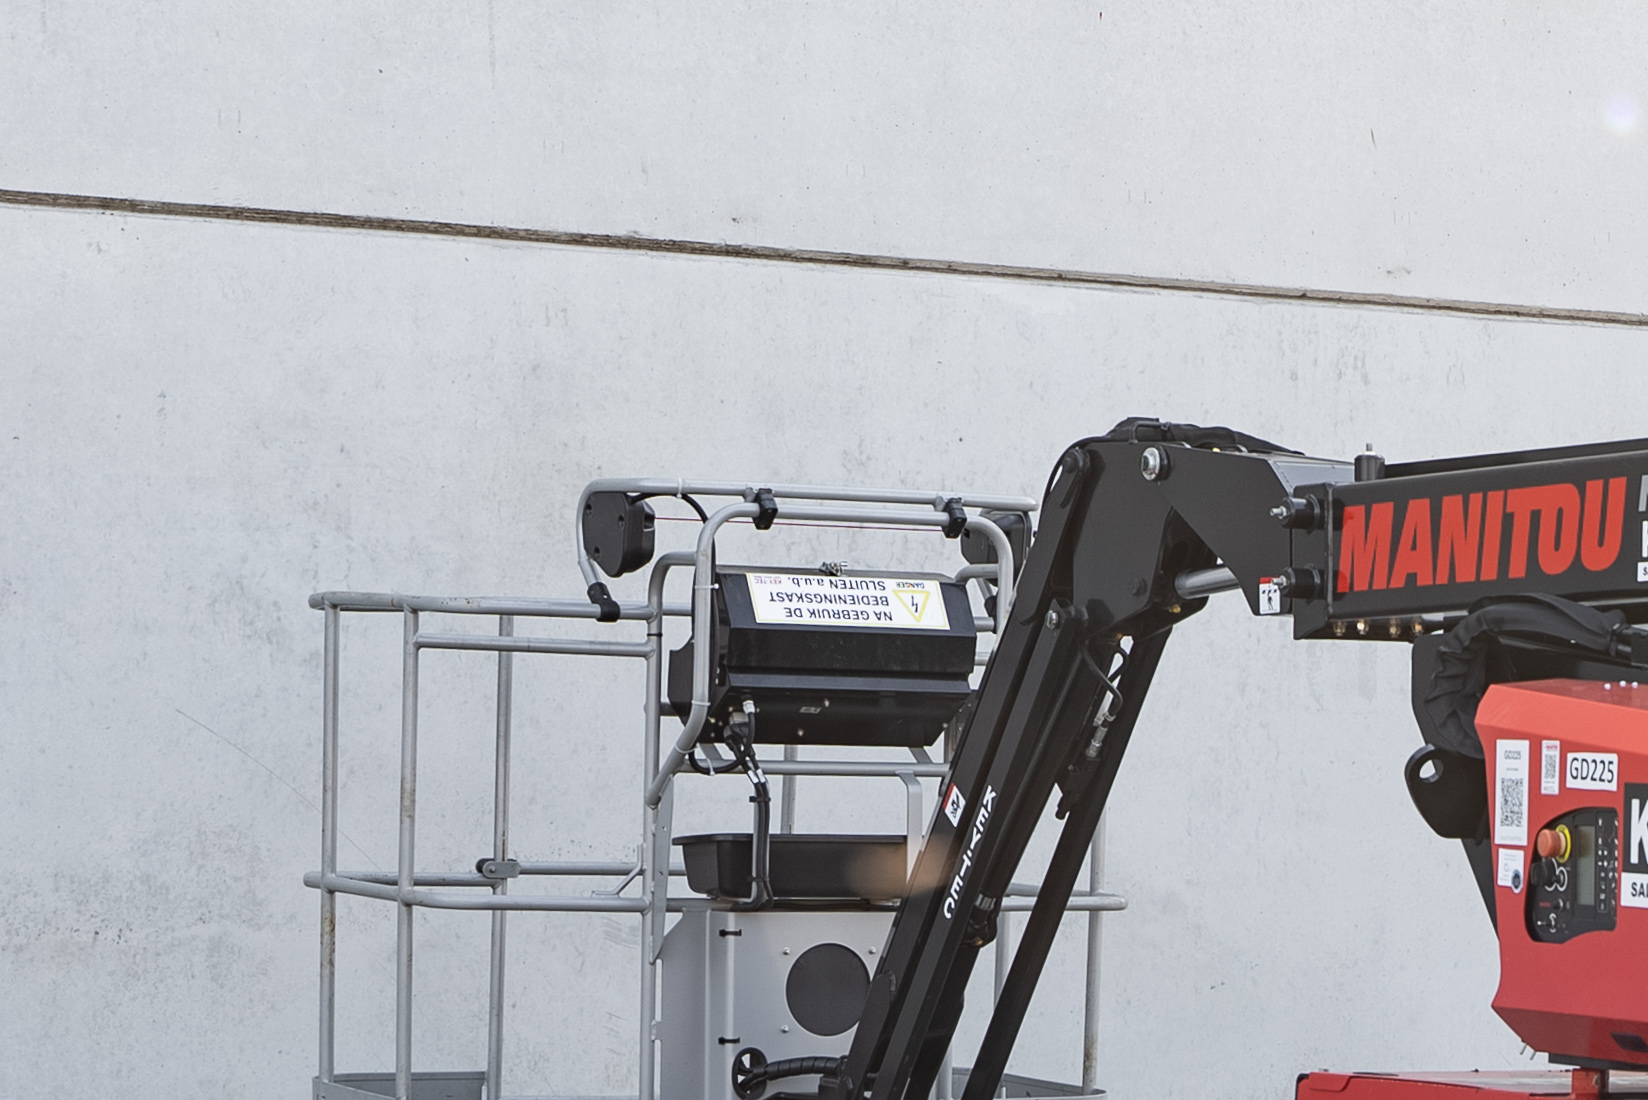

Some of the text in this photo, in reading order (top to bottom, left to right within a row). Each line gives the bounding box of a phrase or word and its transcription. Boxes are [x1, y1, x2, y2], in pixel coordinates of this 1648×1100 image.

[1337, 476, 1628, 594] MANITOU
[787, 576, 824, 587] a.u.b.
[829, 579, 886, 591] SLUITEN
[769, 591, 889, 606] BEDIENINGSKAST
[783, 606, 893, 621] NA GEBRUIK DE
[1569, 757, 1614, 783] GD225
[943, 784, 997, 919] KEY-TEC
